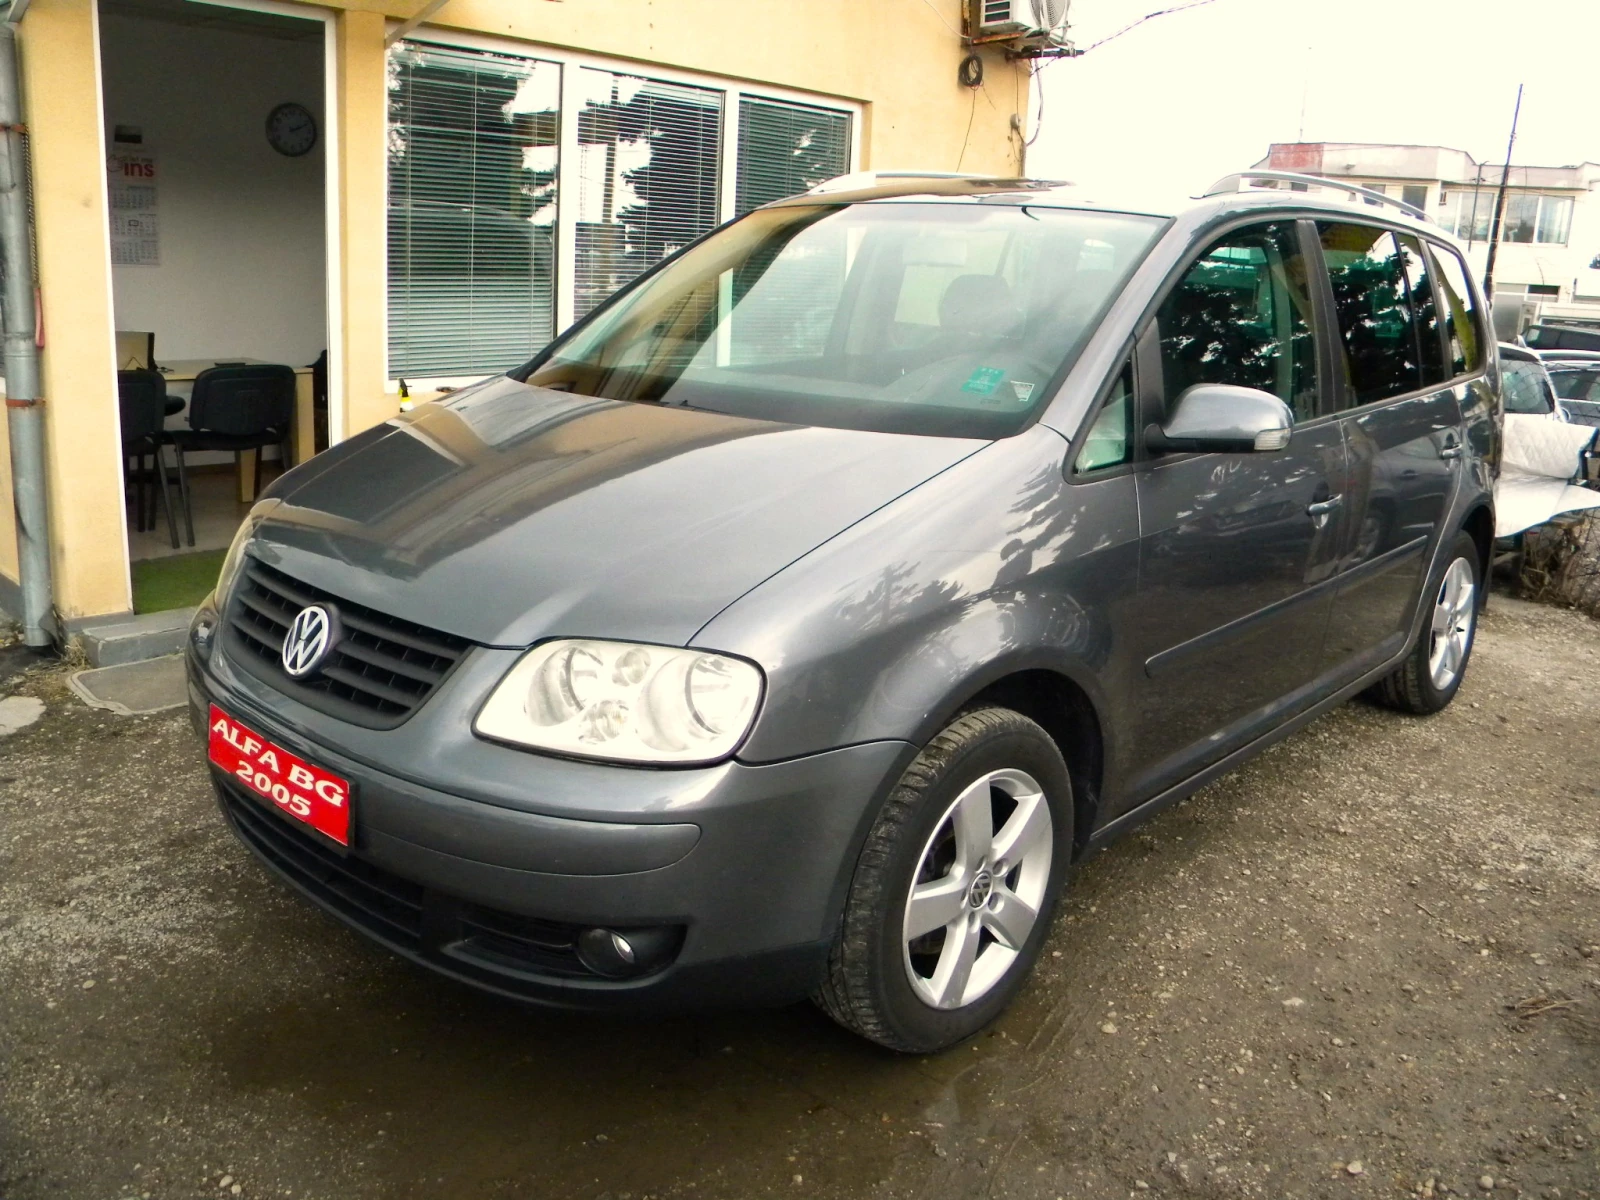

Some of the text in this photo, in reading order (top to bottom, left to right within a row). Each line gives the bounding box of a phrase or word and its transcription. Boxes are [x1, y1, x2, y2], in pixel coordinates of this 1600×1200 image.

[283, 606, 329, 676] VW
[212, 719, 344, 807] ALFA BG
[236, 760, 311, 816] 2005
